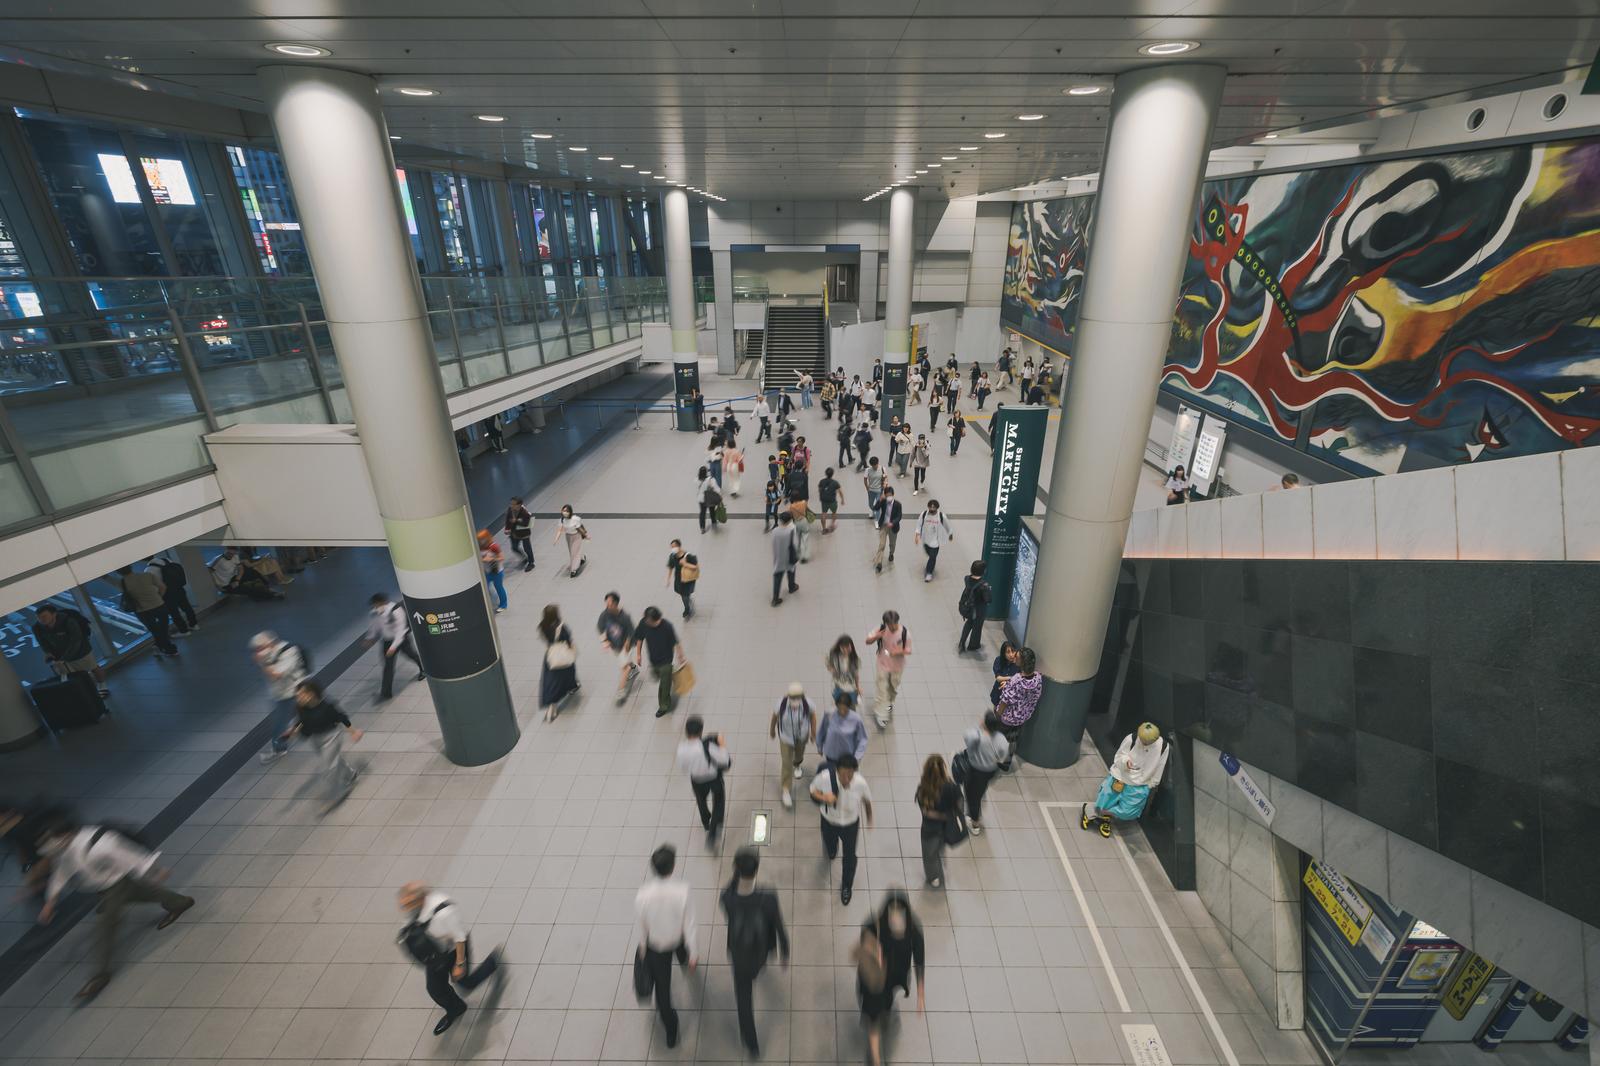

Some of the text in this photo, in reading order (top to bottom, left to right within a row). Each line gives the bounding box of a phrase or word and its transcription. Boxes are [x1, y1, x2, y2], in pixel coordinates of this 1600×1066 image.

[999, 423, 1019, 514] MARK CITY
[1011, 447, 1023, 492] SHIBUYA
